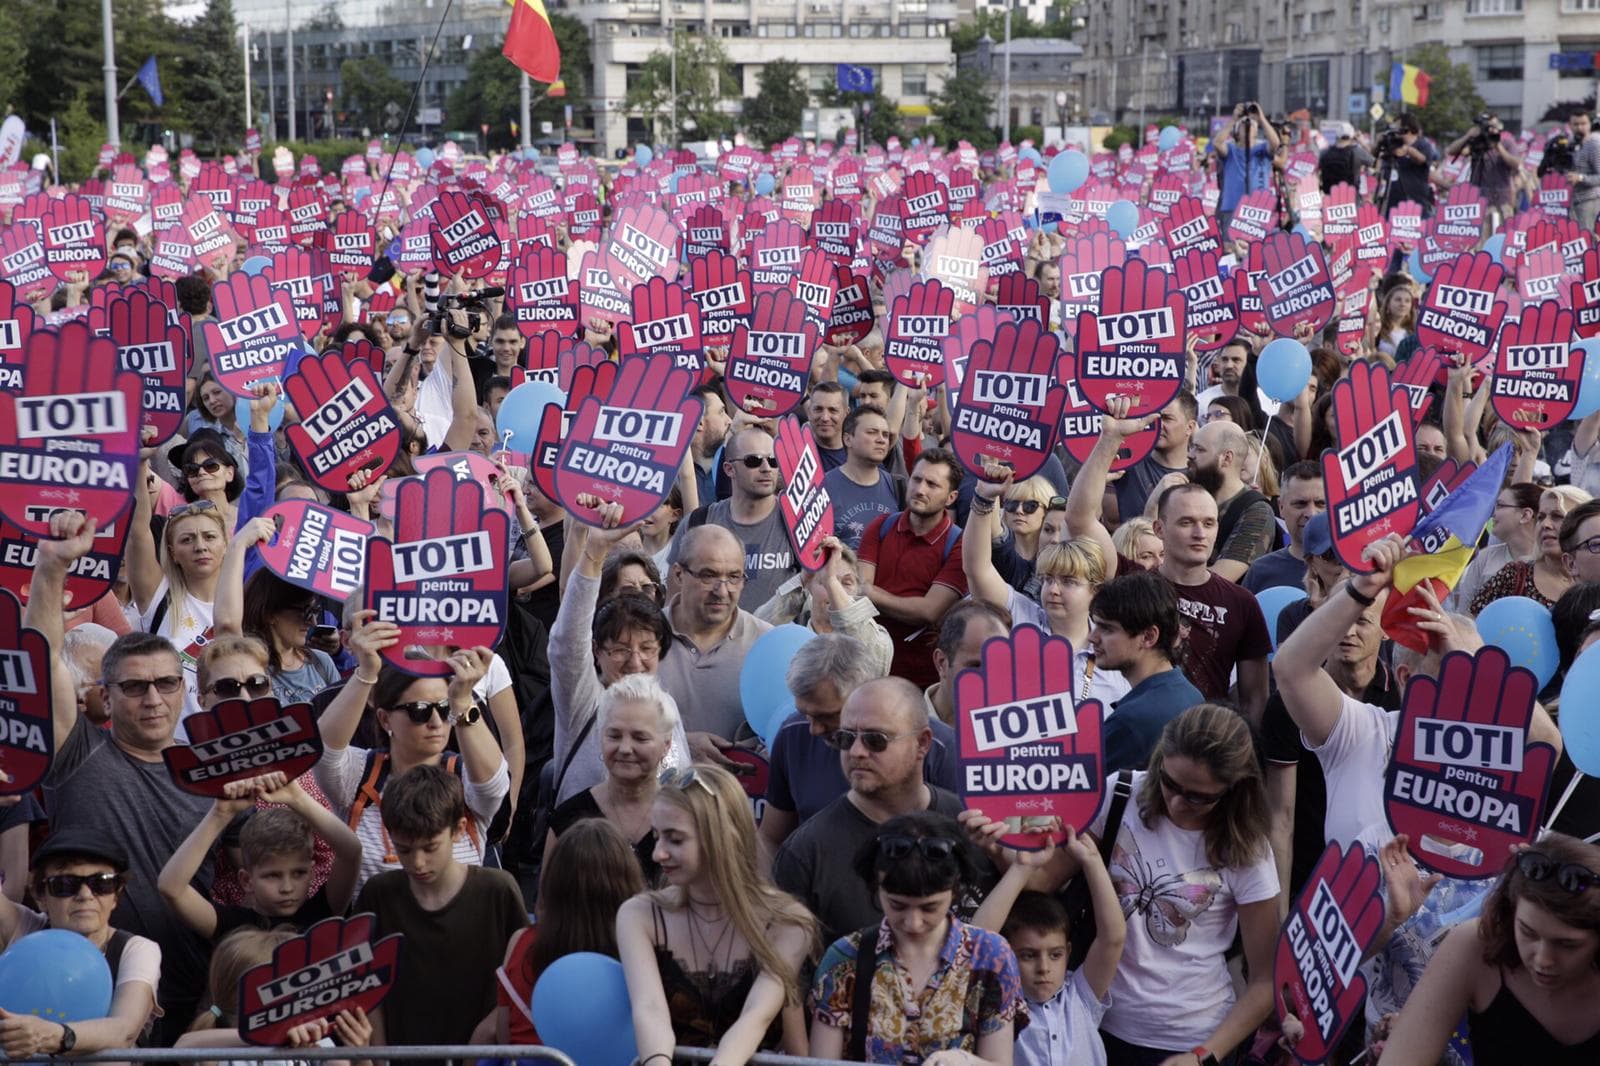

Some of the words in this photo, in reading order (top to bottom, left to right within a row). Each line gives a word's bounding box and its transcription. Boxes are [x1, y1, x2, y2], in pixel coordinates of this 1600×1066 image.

[906, 214, 948, 229] EUROPA
[1231, 220, 1266, 239] EUROPA
[1438, 225, 1479, 236] EUROPA
[48, 248, 101, 262] EUROPA
[330, 253, 372, 266] EUROPA
[401, 252, 432, 261] EUROP
[448, 237, 498, 264] EUROPA
[1358, 247, 1387, 259] EUROPA
[988, 261, 1019, 276] ROPA
[1071, 276, 1100, 292] TO
[1188, 281, 1218, 302] OTI
[1288, 282, 1312, 297] pentru
[1272, 287, 1331, 319] EUROPA
[518, 307, 574, 320] EUROPA
[709, 310, 734, 318] pentru
[1450, 311, 1477, 322] pentru
[1422, 313, 1486, 344] EUROPA
[244, 334, 276, 348] pentru
[652, 344, 680, 353] pentru
[913, 336, 937, 345] pentru
[1119, 344, 1156, 355] pentru
[221, 342, 298, 370] EUROPA
[889, 342, 944, 363] EUROPA
[760, 357, 789, 369] pentru
[1087, 356, 1179, 377] EUROPA
[733, 362, 801, 392] EUROPA
[1525, 370, 1555, 380] pentru
[1496, 378, 1569, 400] EUROPA
[143, 391, 180, 411] OPA
[993, 403, 1028, 419] pentru
[334, 415, 366, 440] pentru
[956, 410, 1041, 449] EUROPA
[1065, 416, 1103, 435] EUR
[46, 439, 100, 453] pentru
[313, 415, 396, 473] EUROPA
[610, 441, 651, 460] pentru
[0, 451, 129, 489] EUROPA
[568, 447, 665, 493] EUROPA
[1363, 467, 1394, 492] pentru
[1338, 476, 1417, 533] EUROPA
[795, 489, 830, 548] EUROPA
[287, 510, 327, 580] EUROPA
[316, 540, 333, 571] pentru
[746, 553, 789, 569] MISM
[422, 580, 469, 594] pentru
[379, 597, 499, 623] EUROPA
[230, 742, 280, 760] pentru
[1010, 744, 1059, 760] pentru
[189, 742, 316, 782] EUROPA
[966, 763, 1090, 791] EUROPA
[1445, 766, 1498, 790] pentru
[1393, 771, 1521, 833] EUROPA
[1313, 939, 1335, 989] pentru
[299, 974, 352, 998] pentru
[1287, 912, 1334, 1040] EUROPA
[249, 974, 382, 1030] EUROPA
